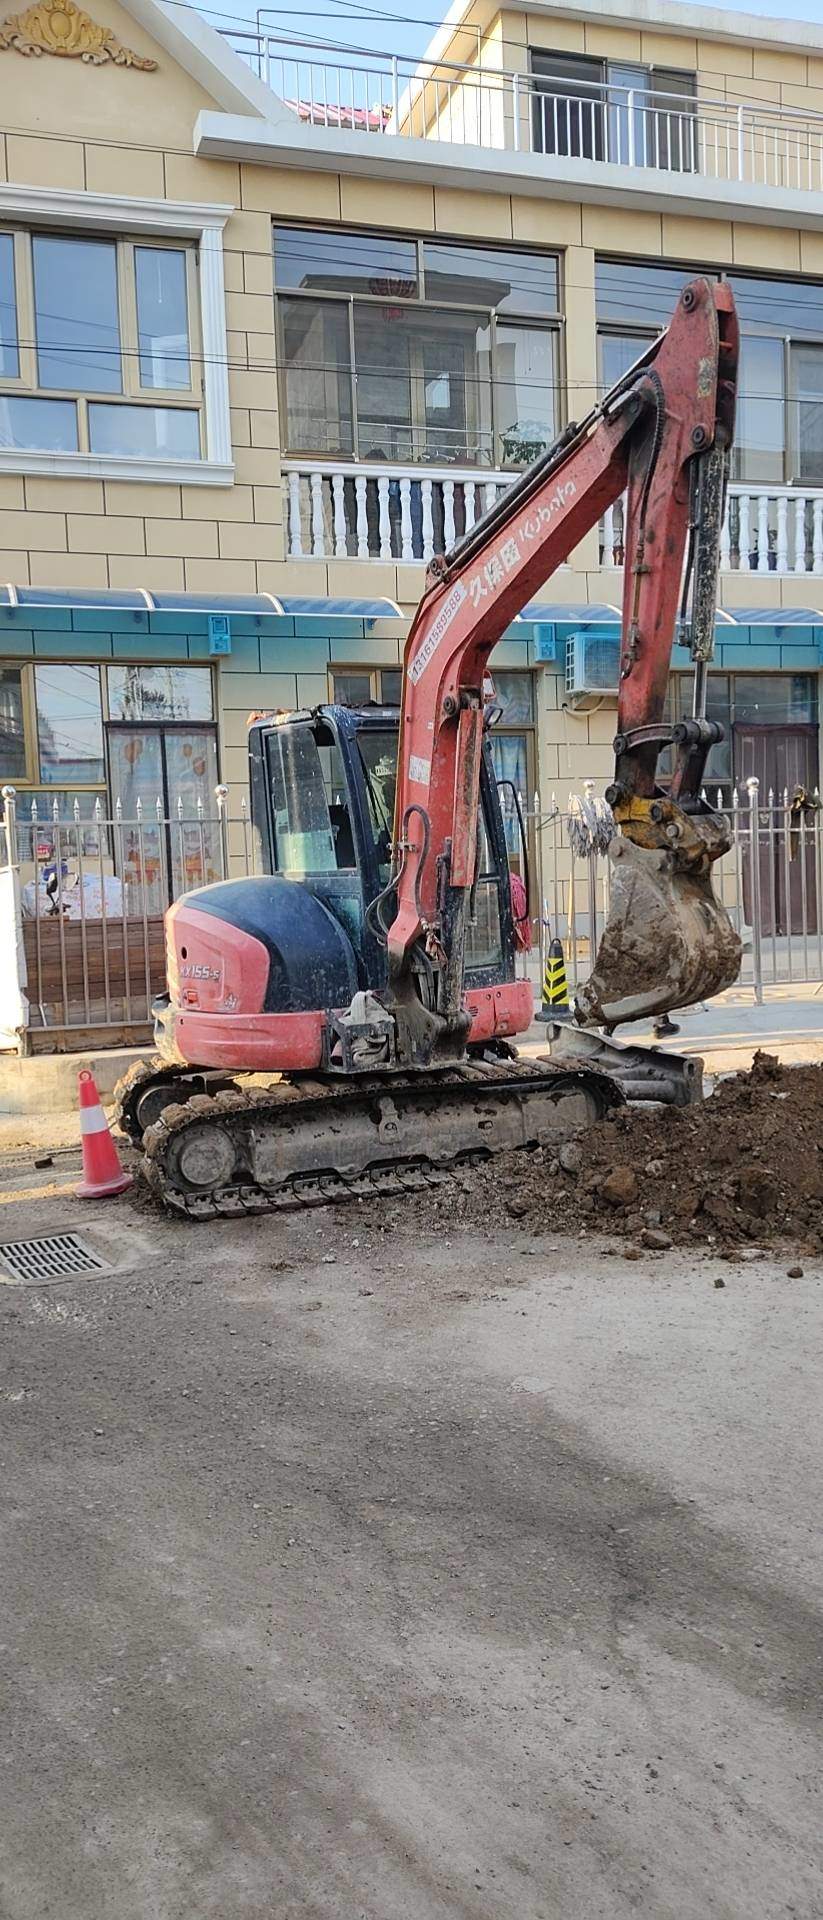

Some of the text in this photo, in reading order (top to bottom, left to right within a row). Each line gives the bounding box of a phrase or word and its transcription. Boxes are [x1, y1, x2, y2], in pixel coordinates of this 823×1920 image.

[469, 480, 577, 608] 久保田 Kubota
[412, 590, 462, 677] 13161589588
